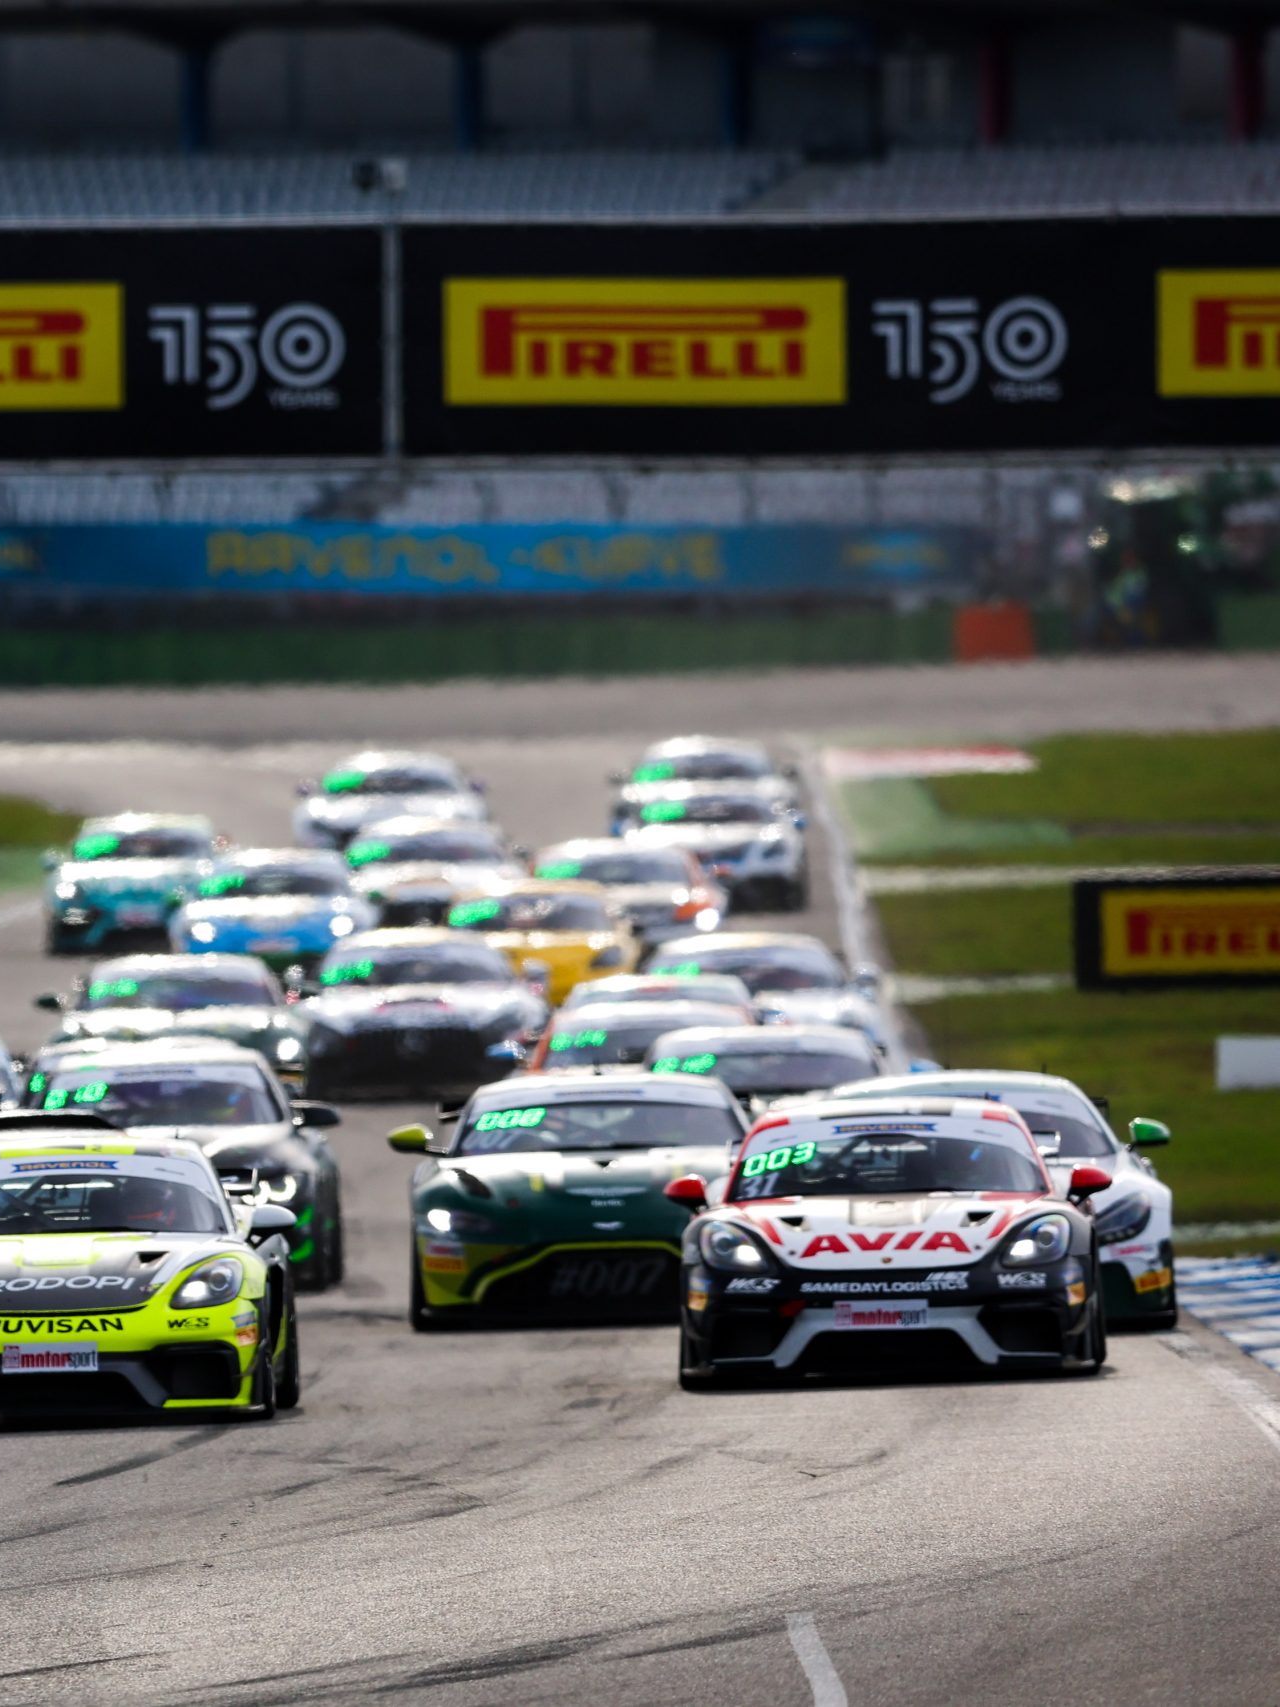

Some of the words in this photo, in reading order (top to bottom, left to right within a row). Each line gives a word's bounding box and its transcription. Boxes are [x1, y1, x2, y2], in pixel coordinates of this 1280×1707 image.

[148, 303, 347, 409] 150
[480, 304, 809, 379] PIRELLI
[872, 296, 1068, 403] 150
[19, 1161, 110, 1171] RAVENOL
[742, 1141, 817, 1177] 003
[799, 1231, 973, 1258] AVIA
[800, 1280, 969, 1293] SAMEDAYLOGISTICS
[20, 1346, 98, 1369] motorsport
